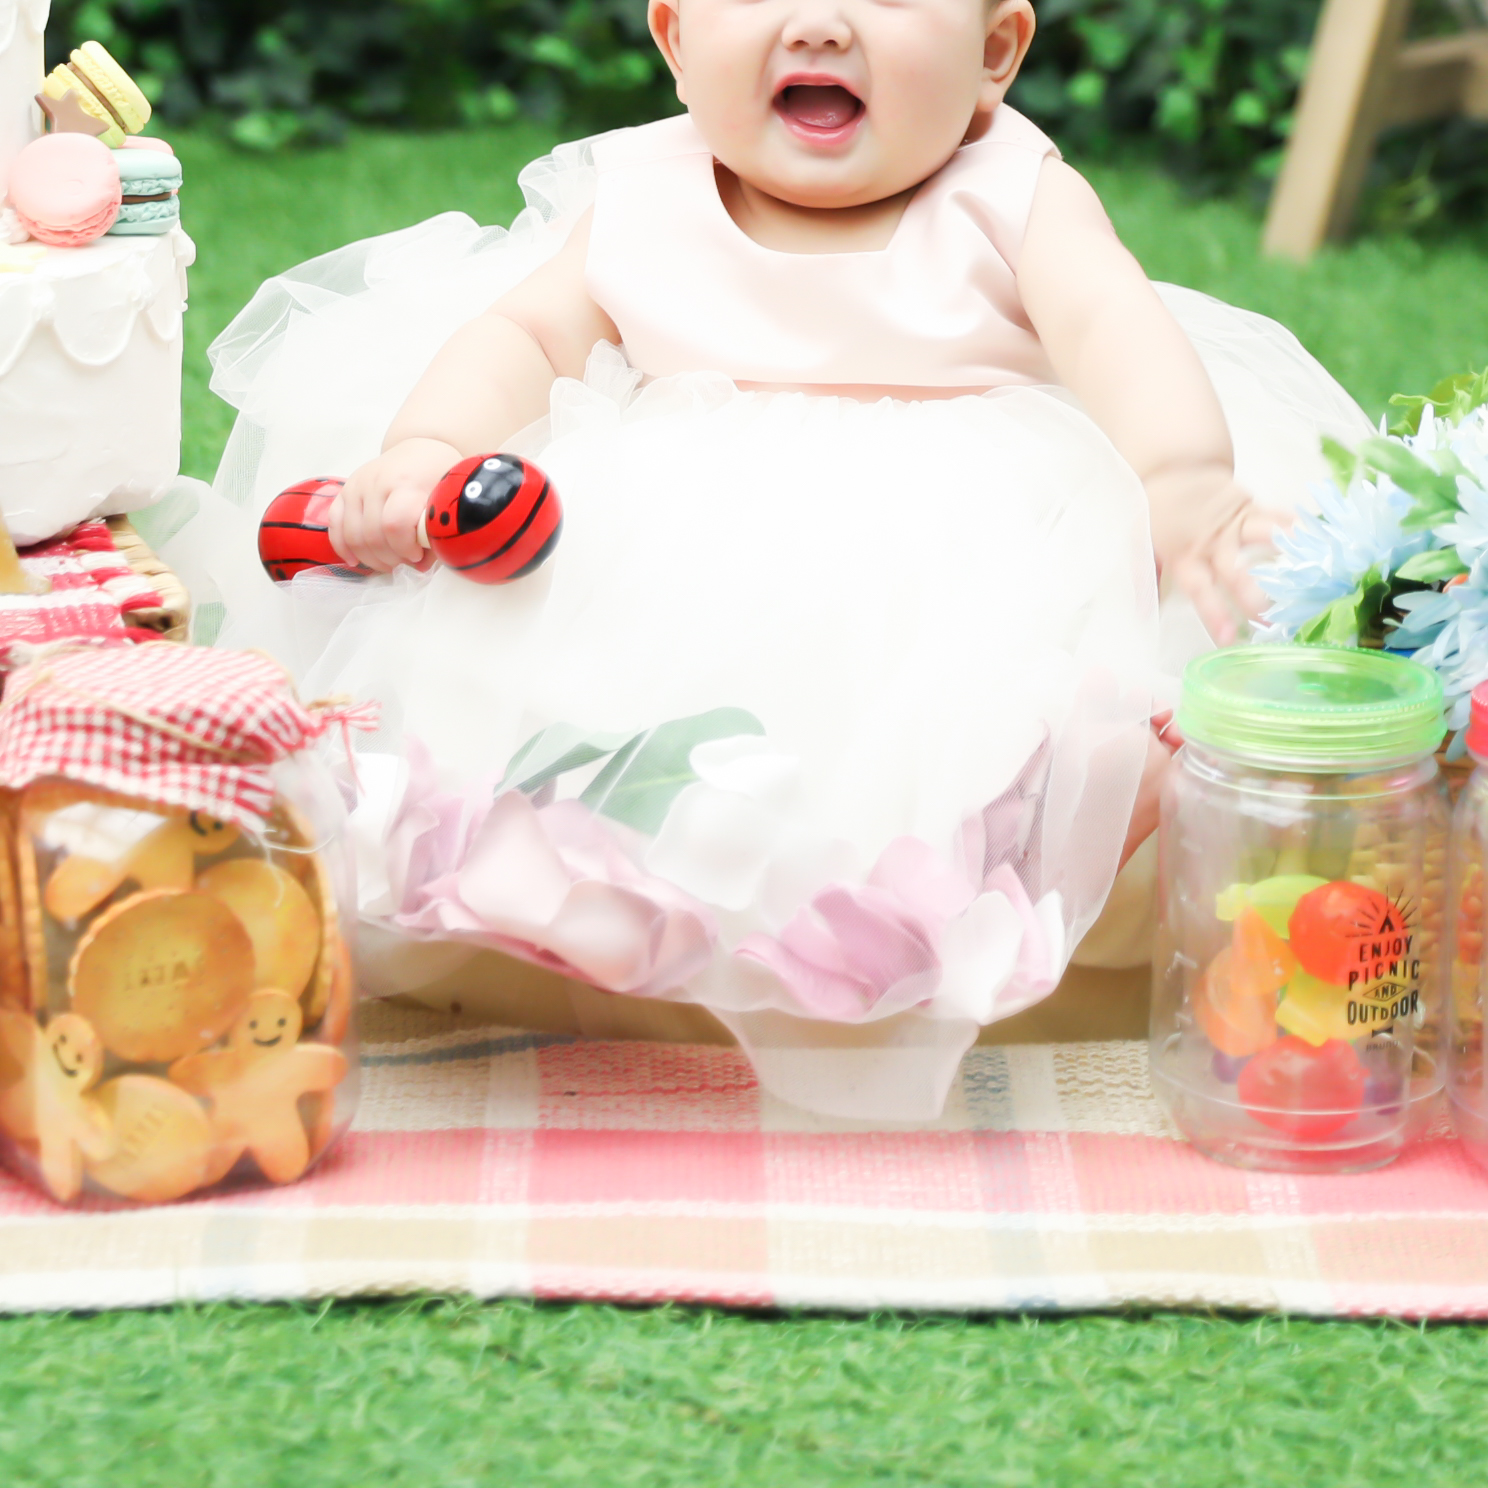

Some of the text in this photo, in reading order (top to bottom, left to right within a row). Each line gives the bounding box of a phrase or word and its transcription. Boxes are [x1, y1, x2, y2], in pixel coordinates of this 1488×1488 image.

[1359, 935, 1413, 962] ENJOY
[1348, 959, 1420, 992] PICNIC
[1374, 984, 1397, 999] AND
[1347, 989, 1419, 1026] OUTDOOR
